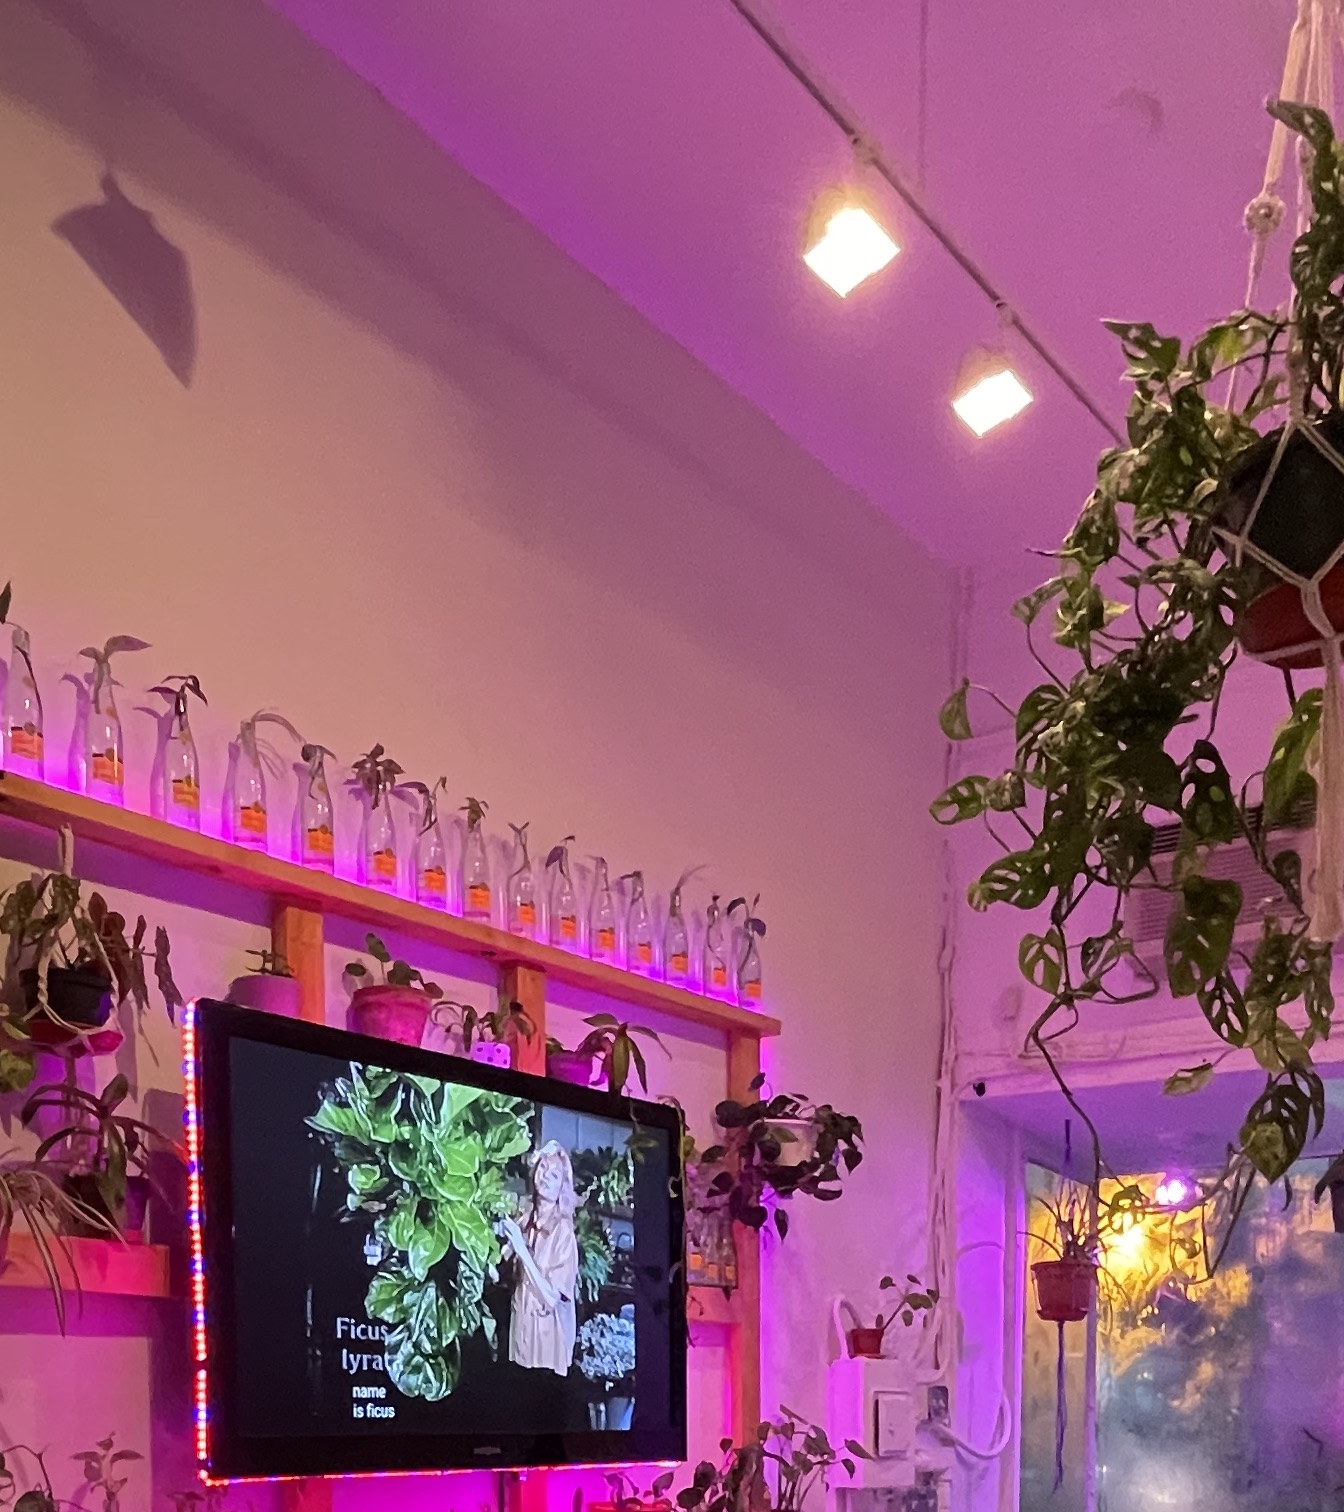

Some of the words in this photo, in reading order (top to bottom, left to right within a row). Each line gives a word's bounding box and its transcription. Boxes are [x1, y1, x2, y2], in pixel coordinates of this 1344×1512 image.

[336, 1317, 388, 1340] Ficus
[352, 1386, 387, 1399] name
[353, 1403, 364, 1418] is
[366, 1402, 396, 1418] ficus
